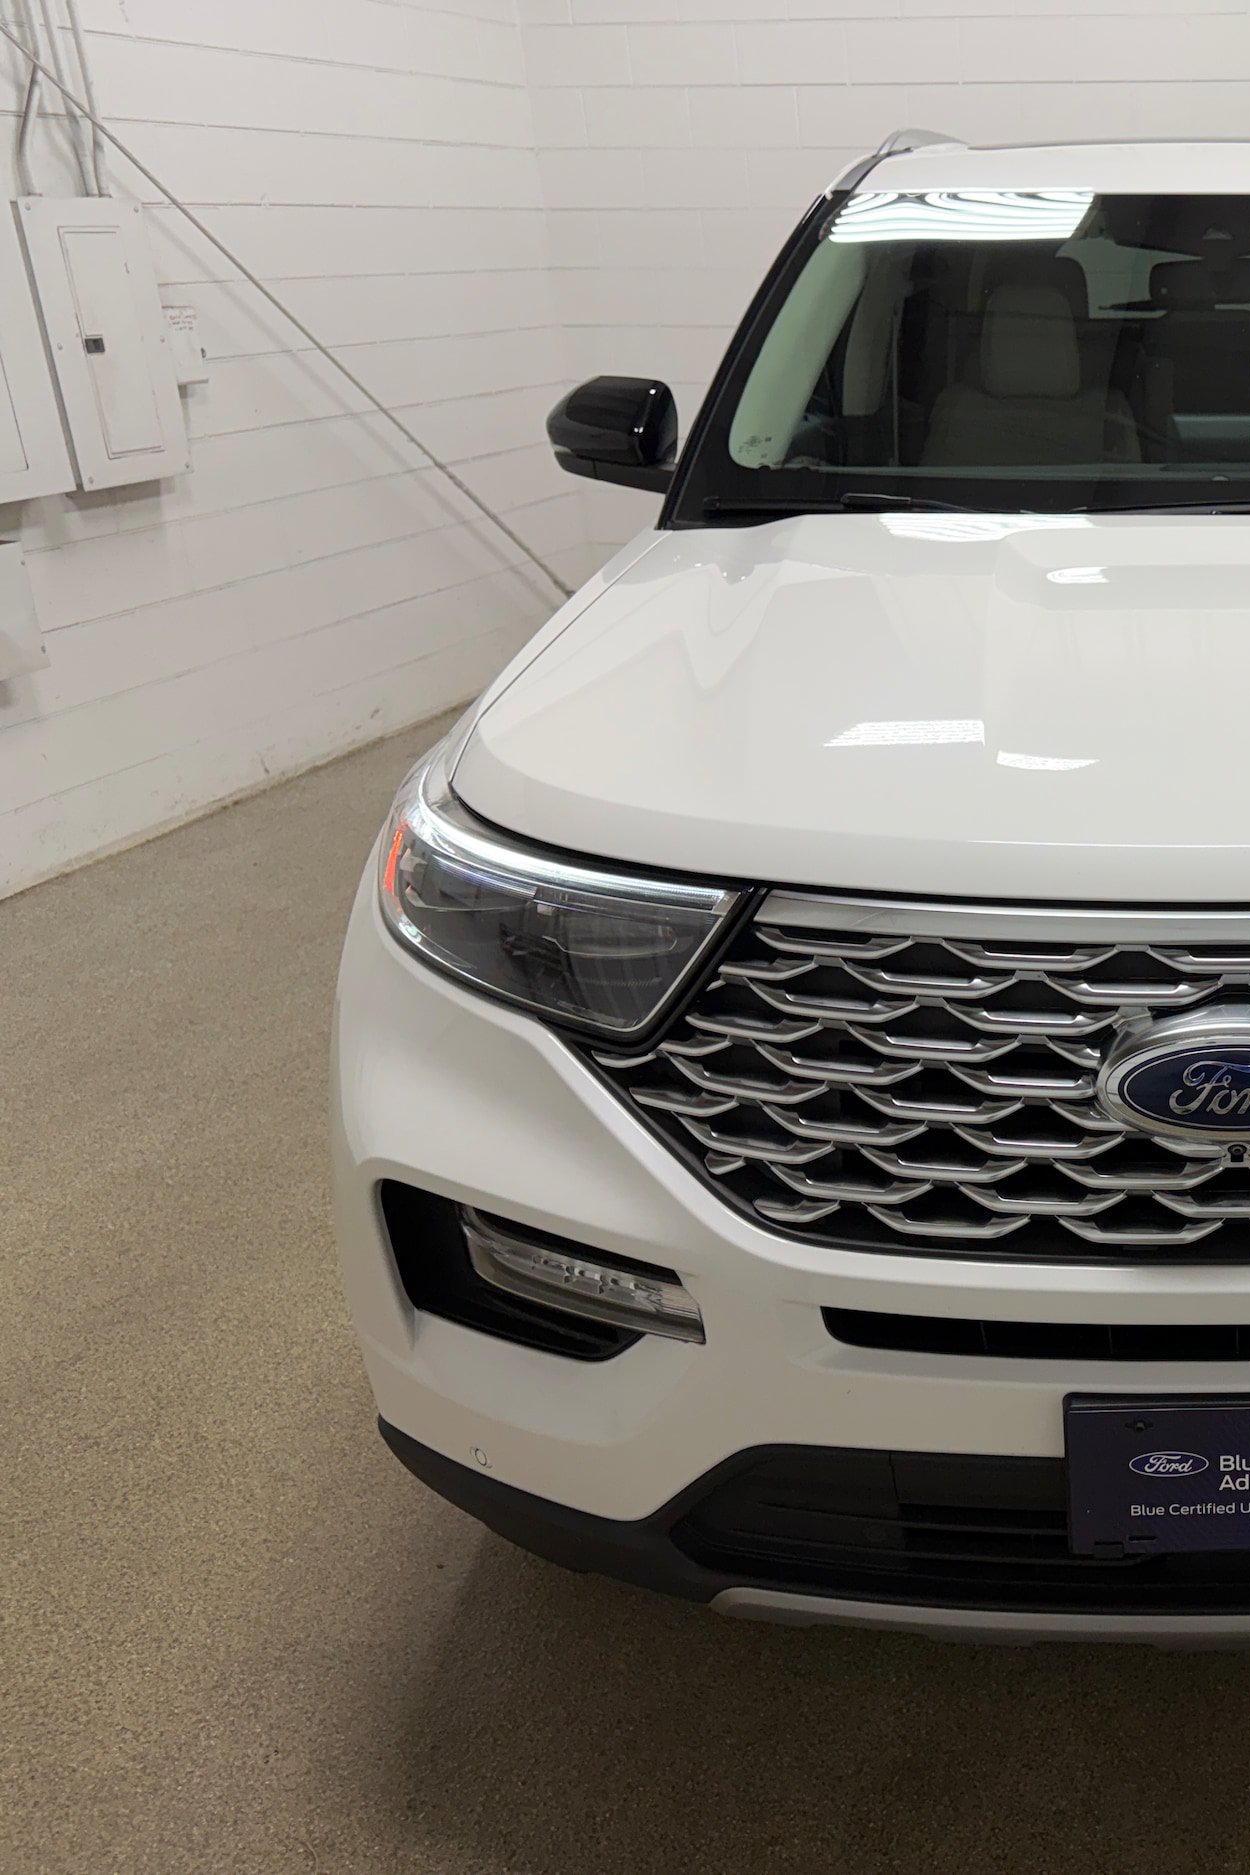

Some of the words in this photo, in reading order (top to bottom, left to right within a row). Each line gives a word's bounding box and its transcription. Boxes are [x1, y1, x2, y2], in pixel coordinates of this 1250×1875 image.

[1144, 1455, 1194, 1472] Ford
[1130, 1504, 1166, 1517] Blue
[1168, 1502, 1236, 1516] Certified
